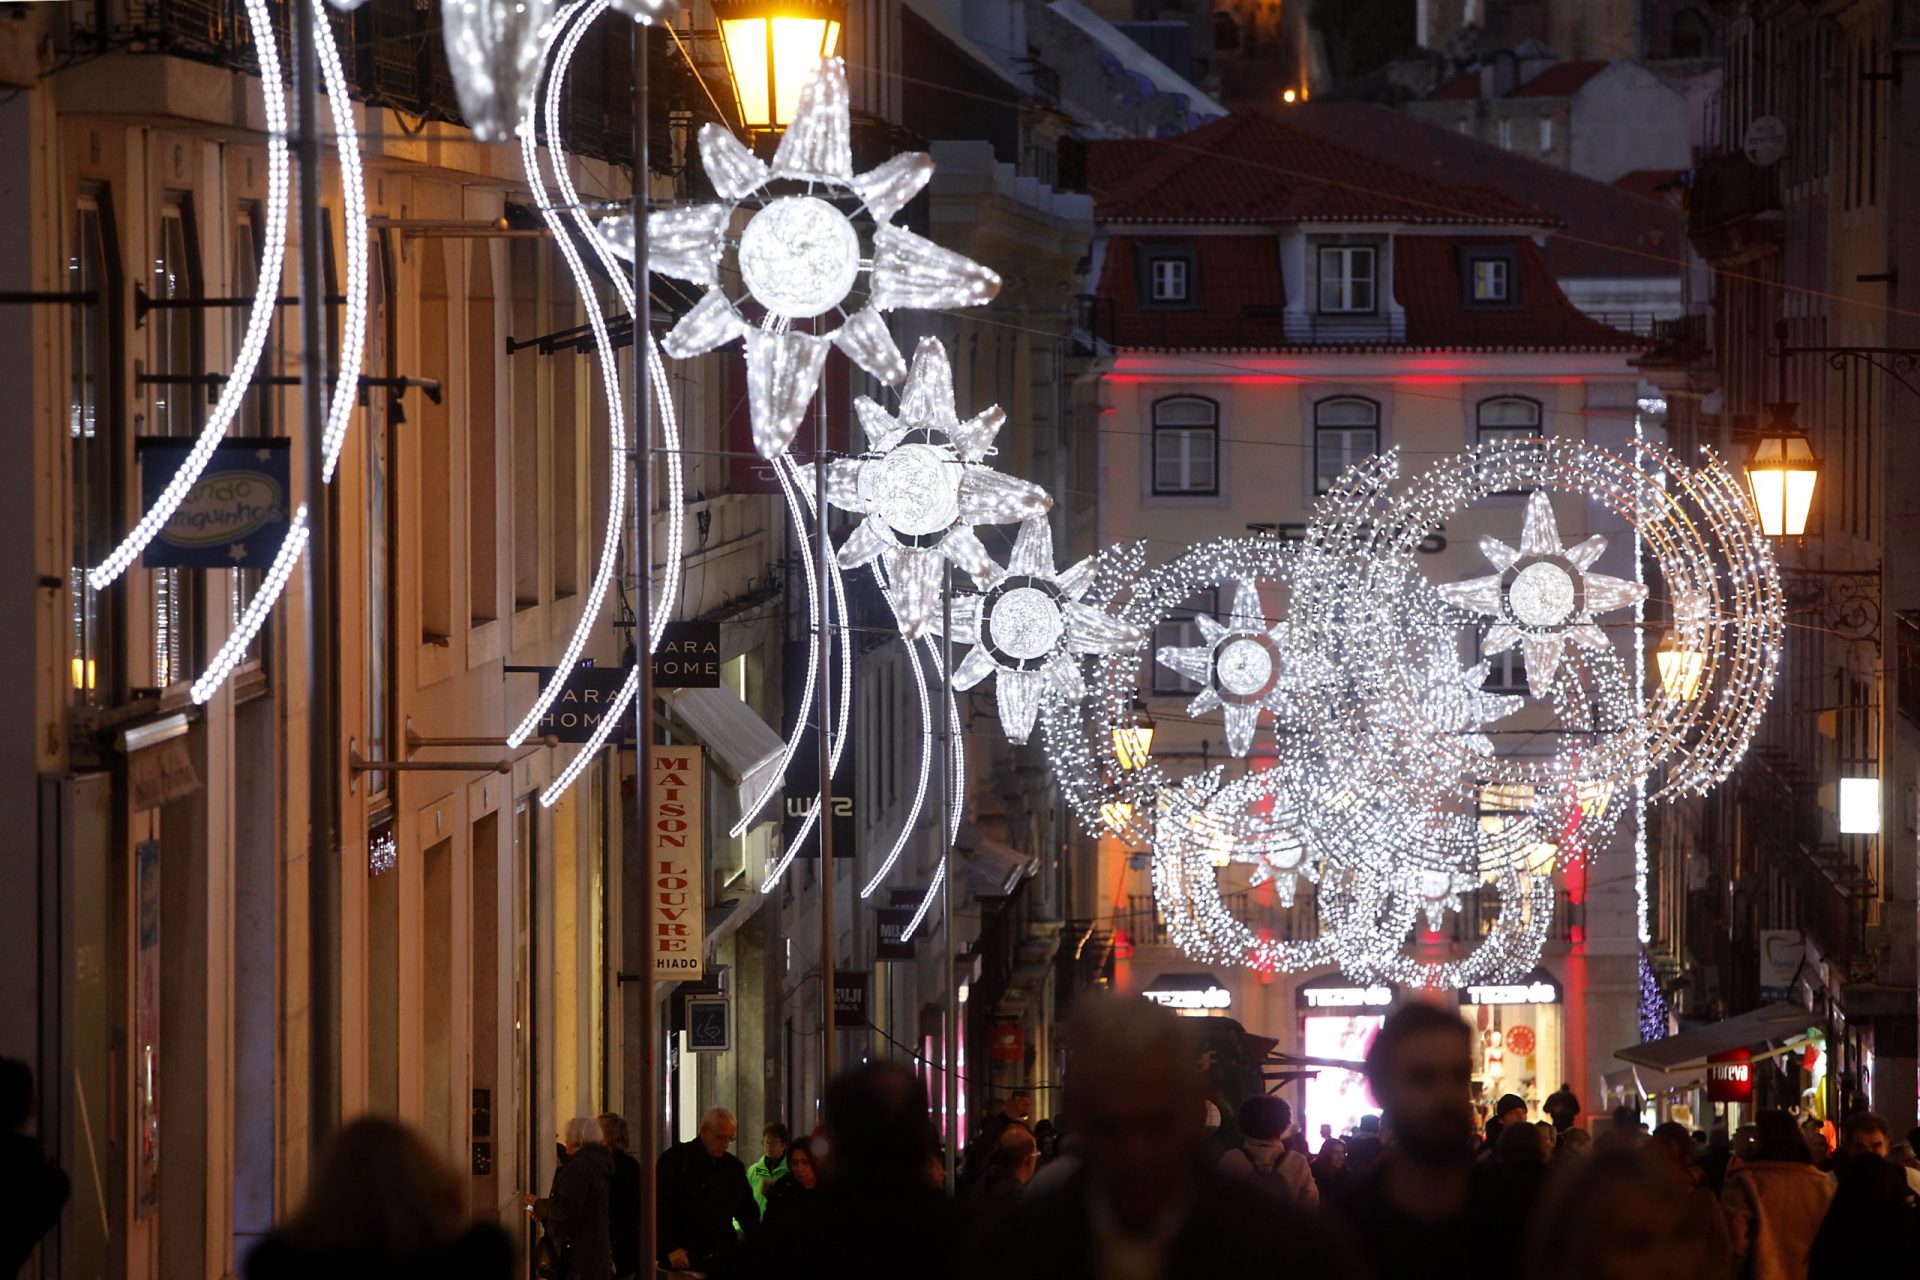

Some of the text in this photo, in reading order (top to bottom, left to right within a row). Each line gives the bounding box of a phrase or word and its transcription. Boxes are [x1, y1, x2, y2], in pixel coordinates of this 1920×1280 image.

[653, 641, 718, 652] ARA
[540, 713, 622, 728] HOM
[654, 757, 690, 952] MAISON LOUVRE
[652, 958, 698, 969] HIADO
